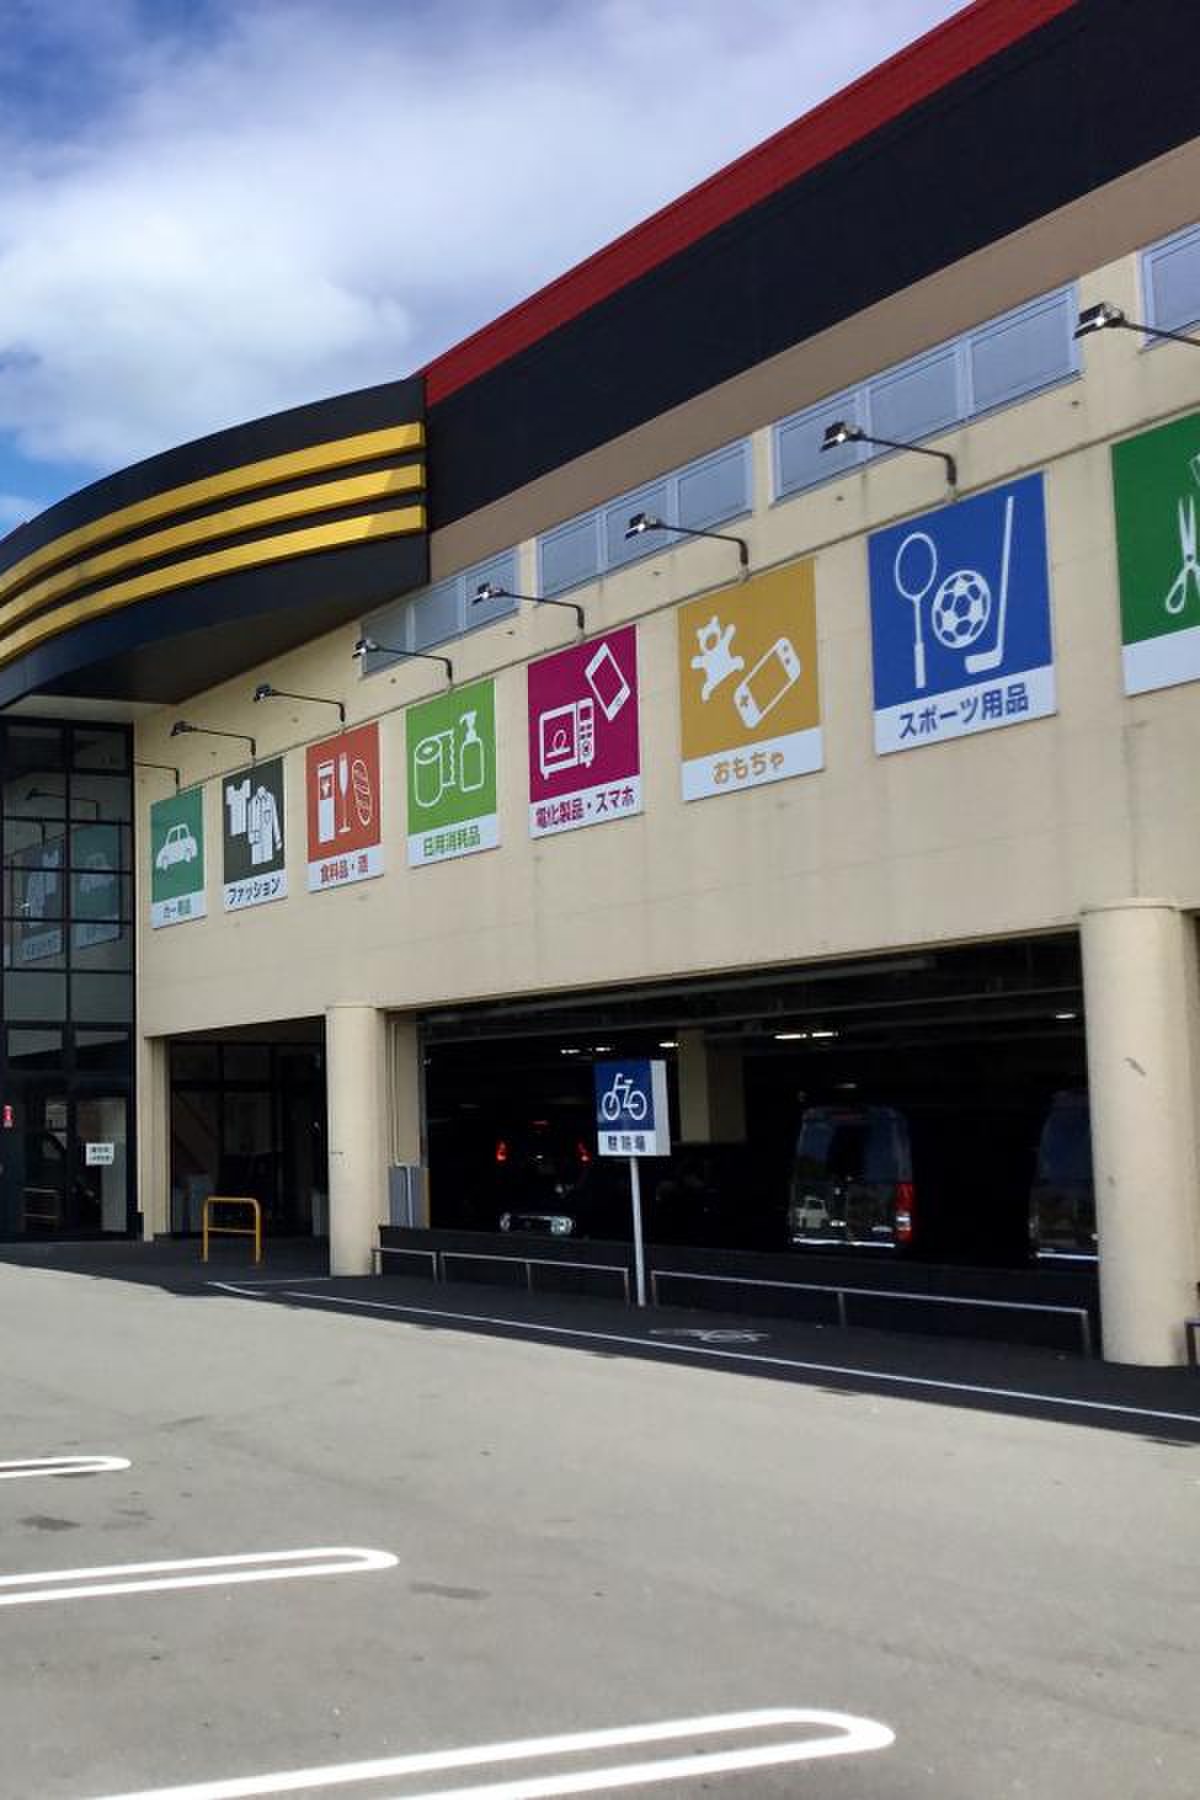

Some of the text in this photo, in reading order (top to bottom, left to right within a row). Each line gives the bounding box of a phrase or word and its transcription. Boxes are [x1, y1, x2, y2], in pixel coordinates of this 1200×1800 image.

[899, 682, 1029, 739] スポーツ用品
[713, 752, 785, 785] おもちゃ
[535, 786, 635, 829] 電化製品・スマホ
[227, 878, 281, 905] ファッション
